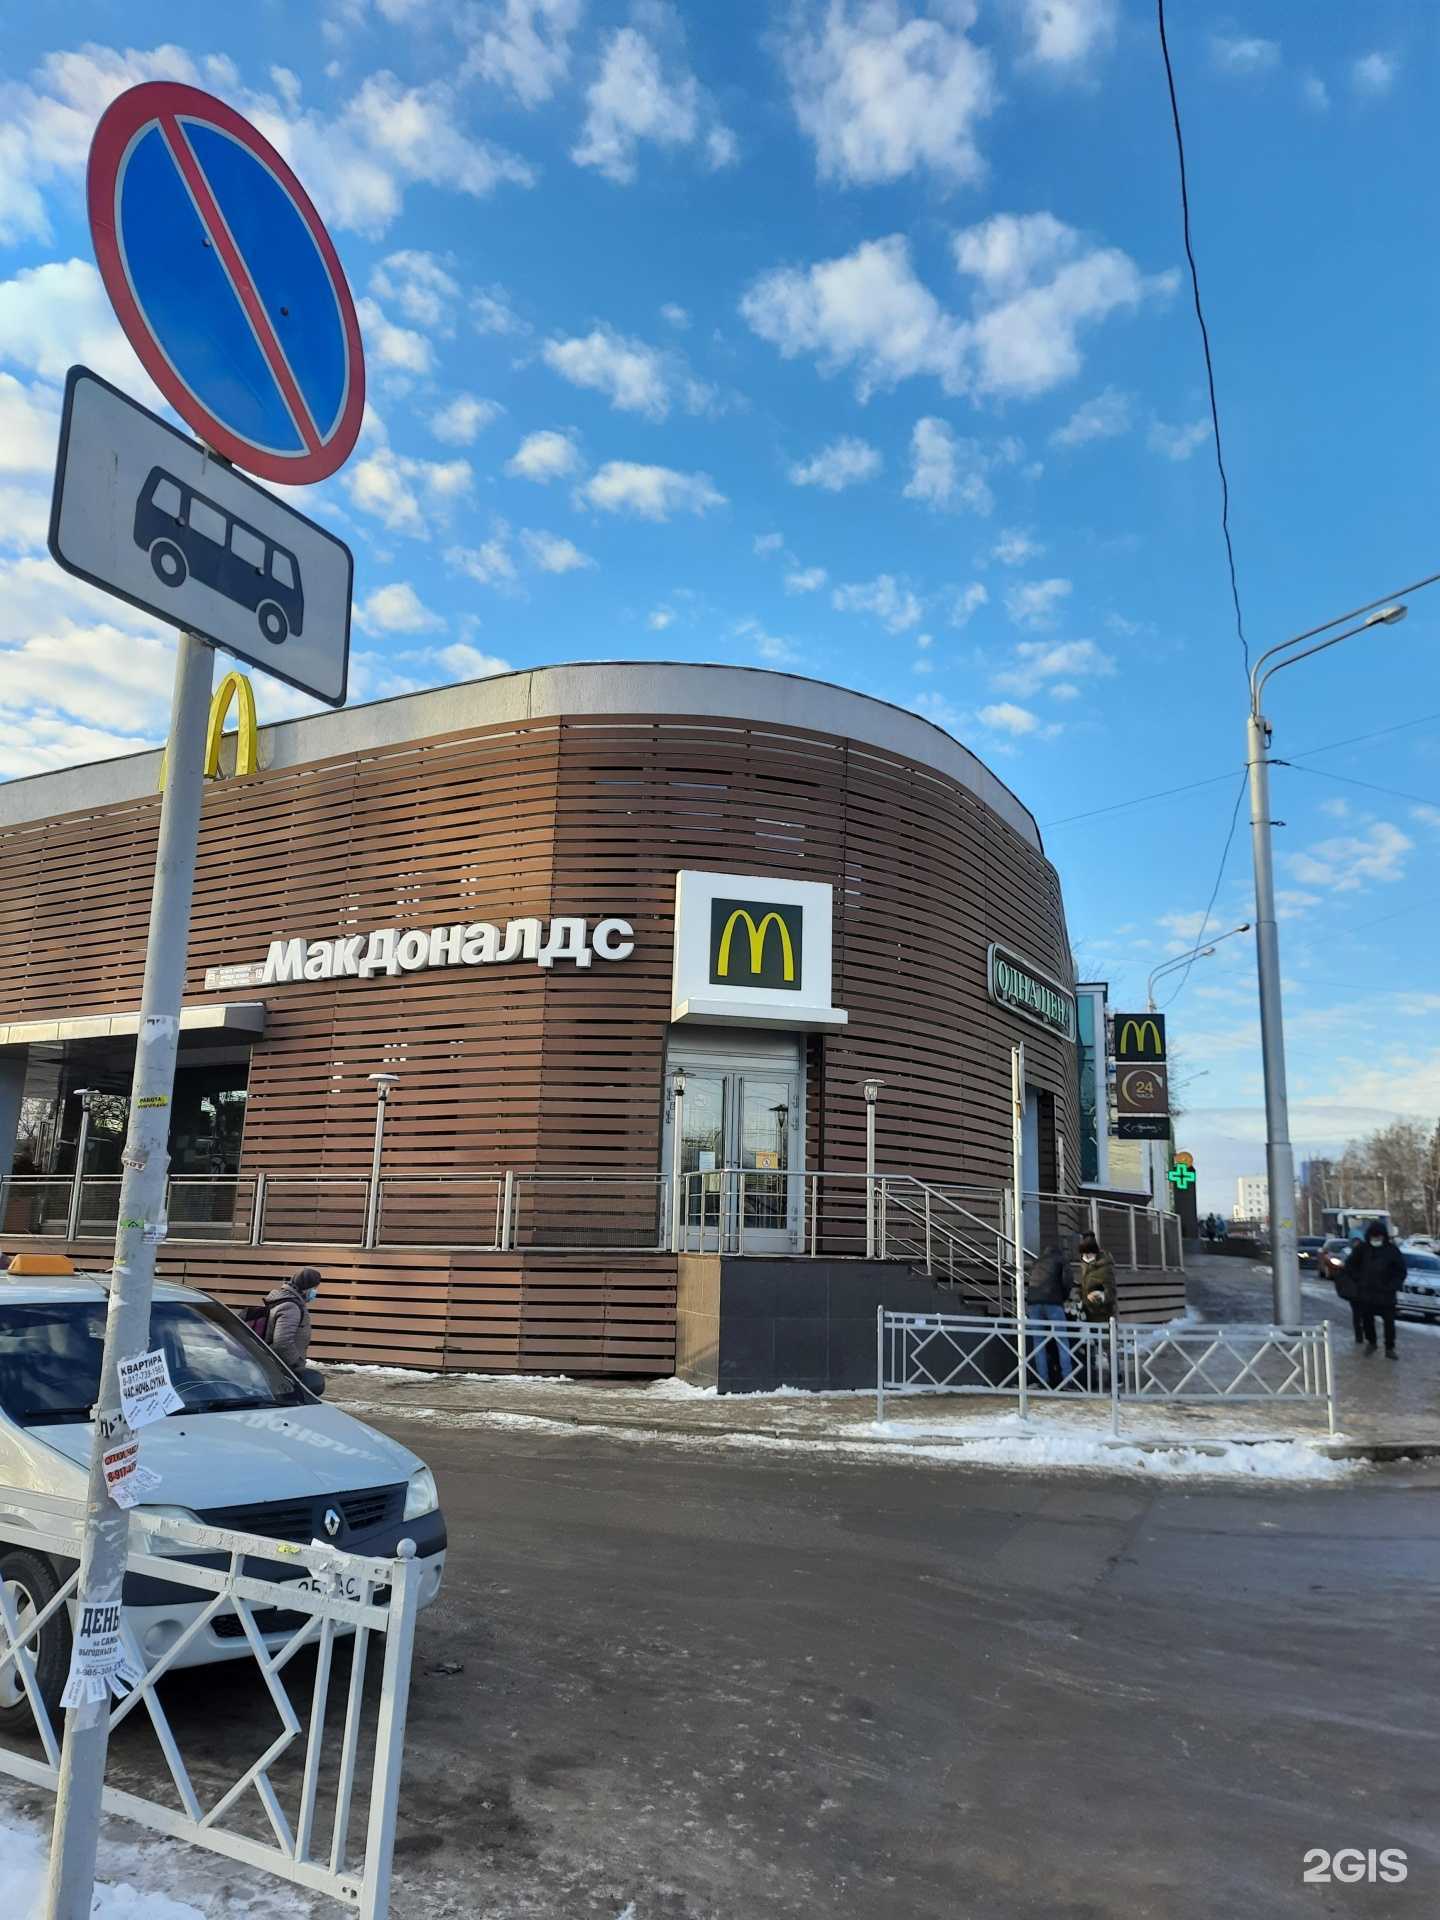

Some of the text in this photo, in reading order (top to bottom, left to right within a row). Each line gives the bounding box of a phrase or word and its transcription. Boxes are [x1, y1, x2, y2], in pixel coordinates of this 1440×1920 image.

[997, 960, 1040, 1011] ОДНА
[1135, 1081, 1154, 1094] 24
[120, 1355, 162, 1377] КВАРТИРА
